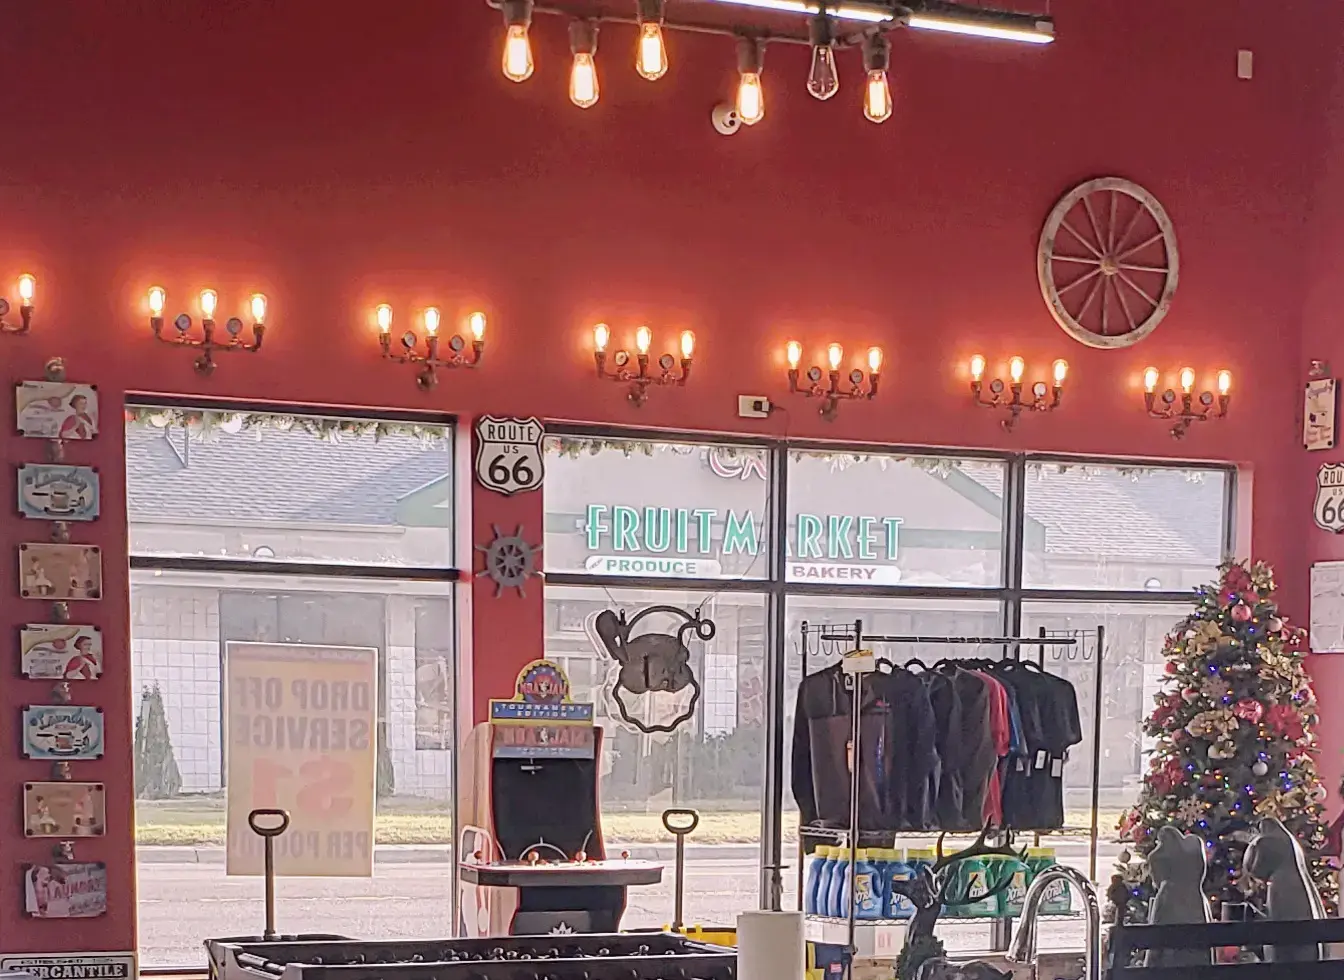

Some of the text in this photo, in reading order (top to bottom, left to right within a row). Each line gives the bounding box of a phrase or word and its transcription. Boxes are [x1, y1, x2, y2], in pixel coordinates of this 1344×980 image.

[488, 424, 534, 441] ROUTE
[503, 445, 519, 454] US
[488, 454, 534, 486] 66
[1332, 487, 1343, 496] US
[722, 507, 905, 561] MRKET
[606, 559, 697, 575] PRODUCE
[792, 565, 878, 581] BAKERY
[501, 703, 582, 712] TOURNAMENT
